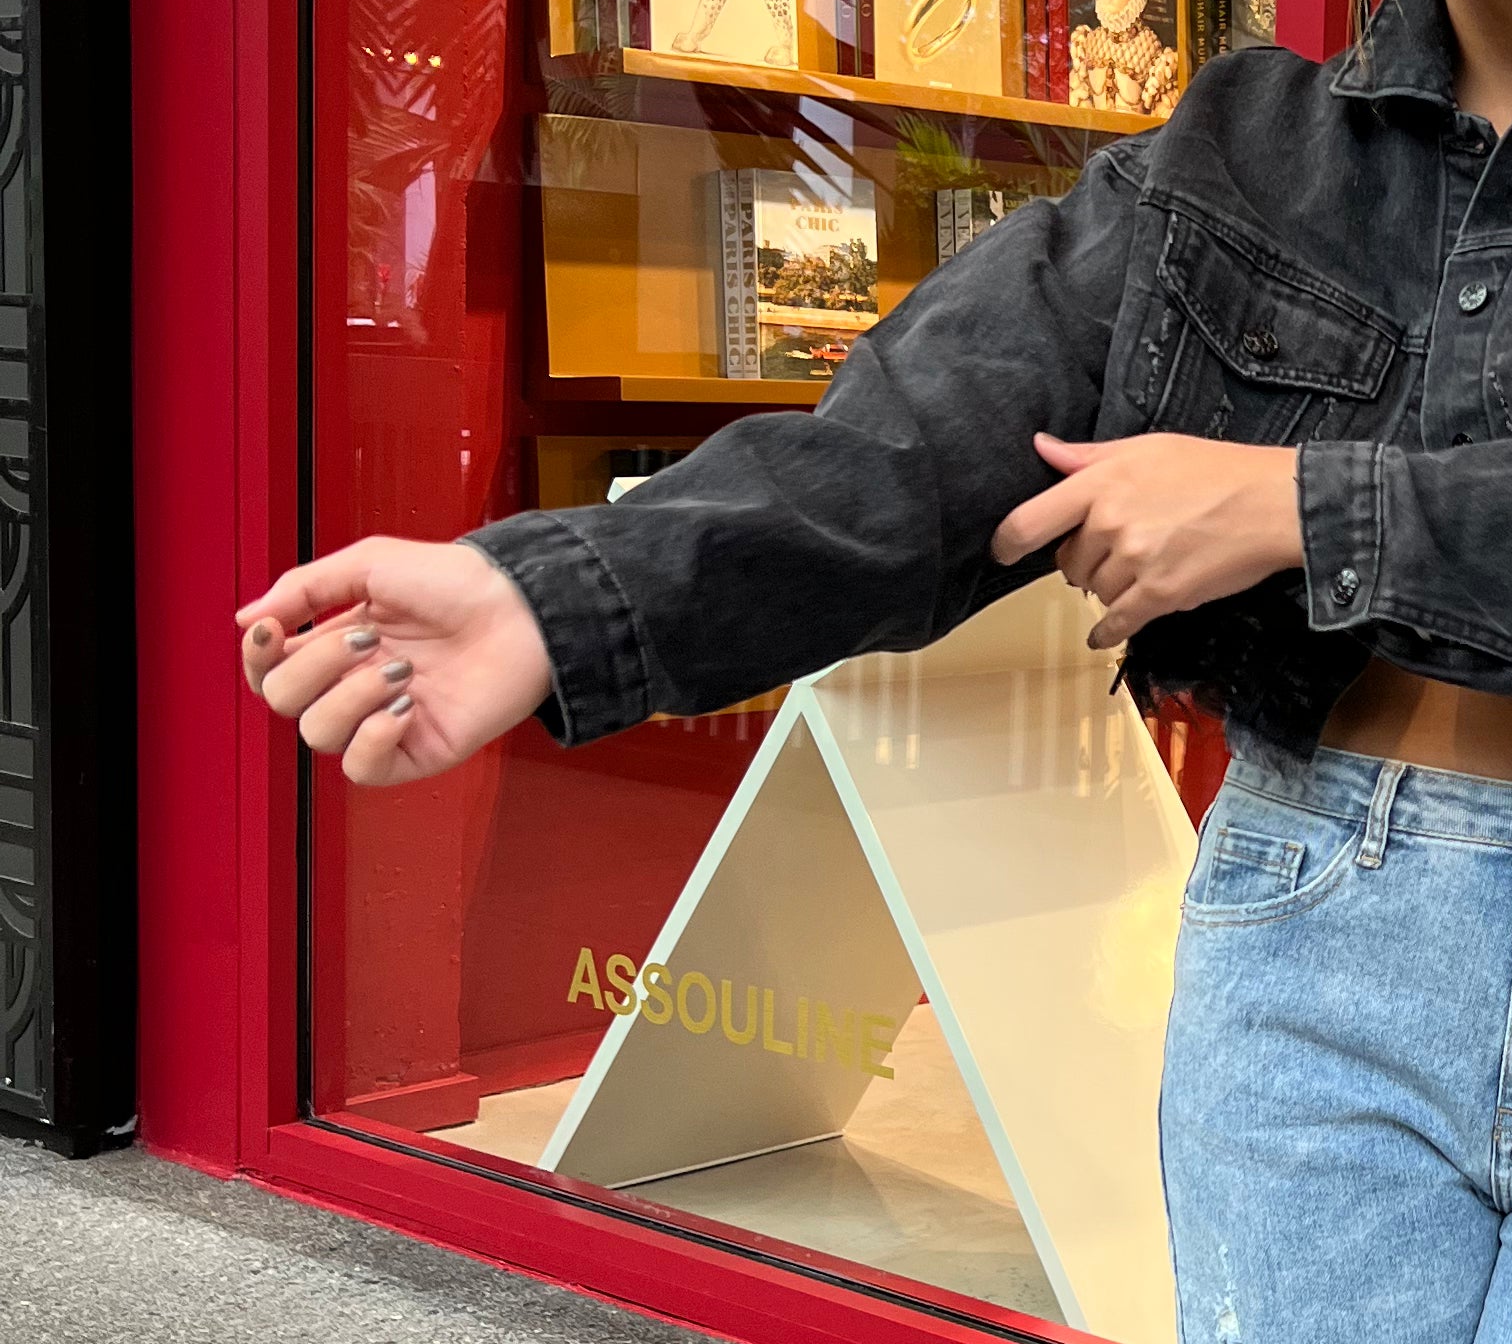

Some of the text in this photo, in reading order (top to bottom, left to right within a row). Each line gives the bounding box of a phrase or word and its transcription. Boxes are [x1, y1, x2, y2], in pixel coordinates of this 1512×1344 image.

[724, 203, 741, 366] PARIS CHIC
[741, 202, 757, 366] PARIS CHIC
[795, 215, 840, 233] CHIC
[567, 946, 897, 1080] ASSOULINE
